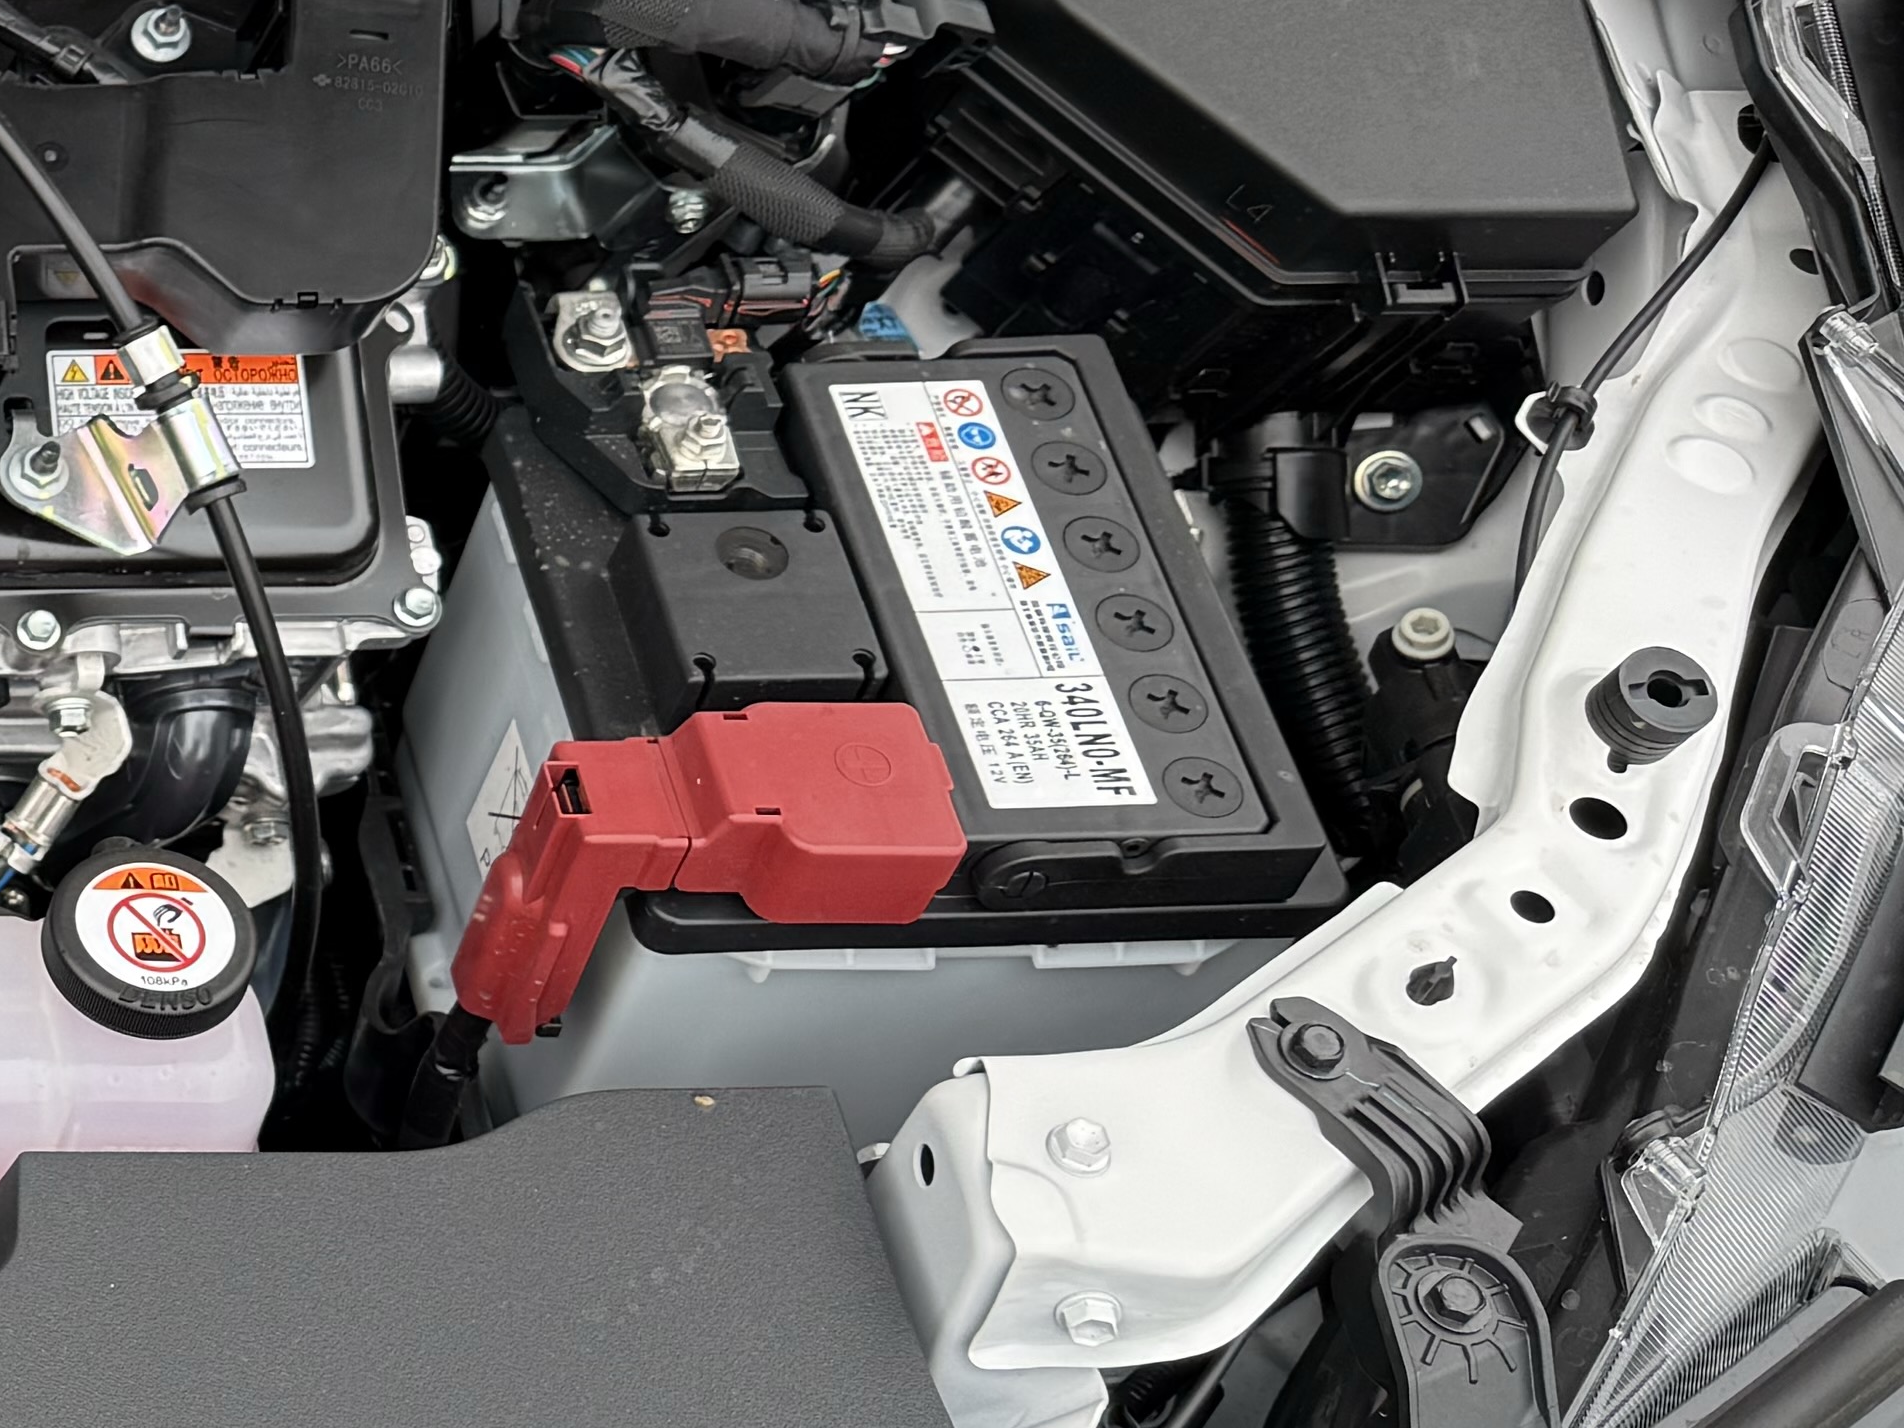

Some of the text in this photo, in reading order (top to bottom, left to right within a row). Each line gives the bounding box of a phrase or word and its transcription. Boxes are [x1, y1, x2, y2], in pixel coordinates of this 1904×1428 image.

[838, 391, 887, 419] NK
[985, 701, 1011, 724] CCA
[996, 728, 1020, 746] 264
[1009, 701, 1049, 760] 20HR 35AH
[986, 762, 1007, 783] 12V
[118, 987, 213, 1011] DENSO
